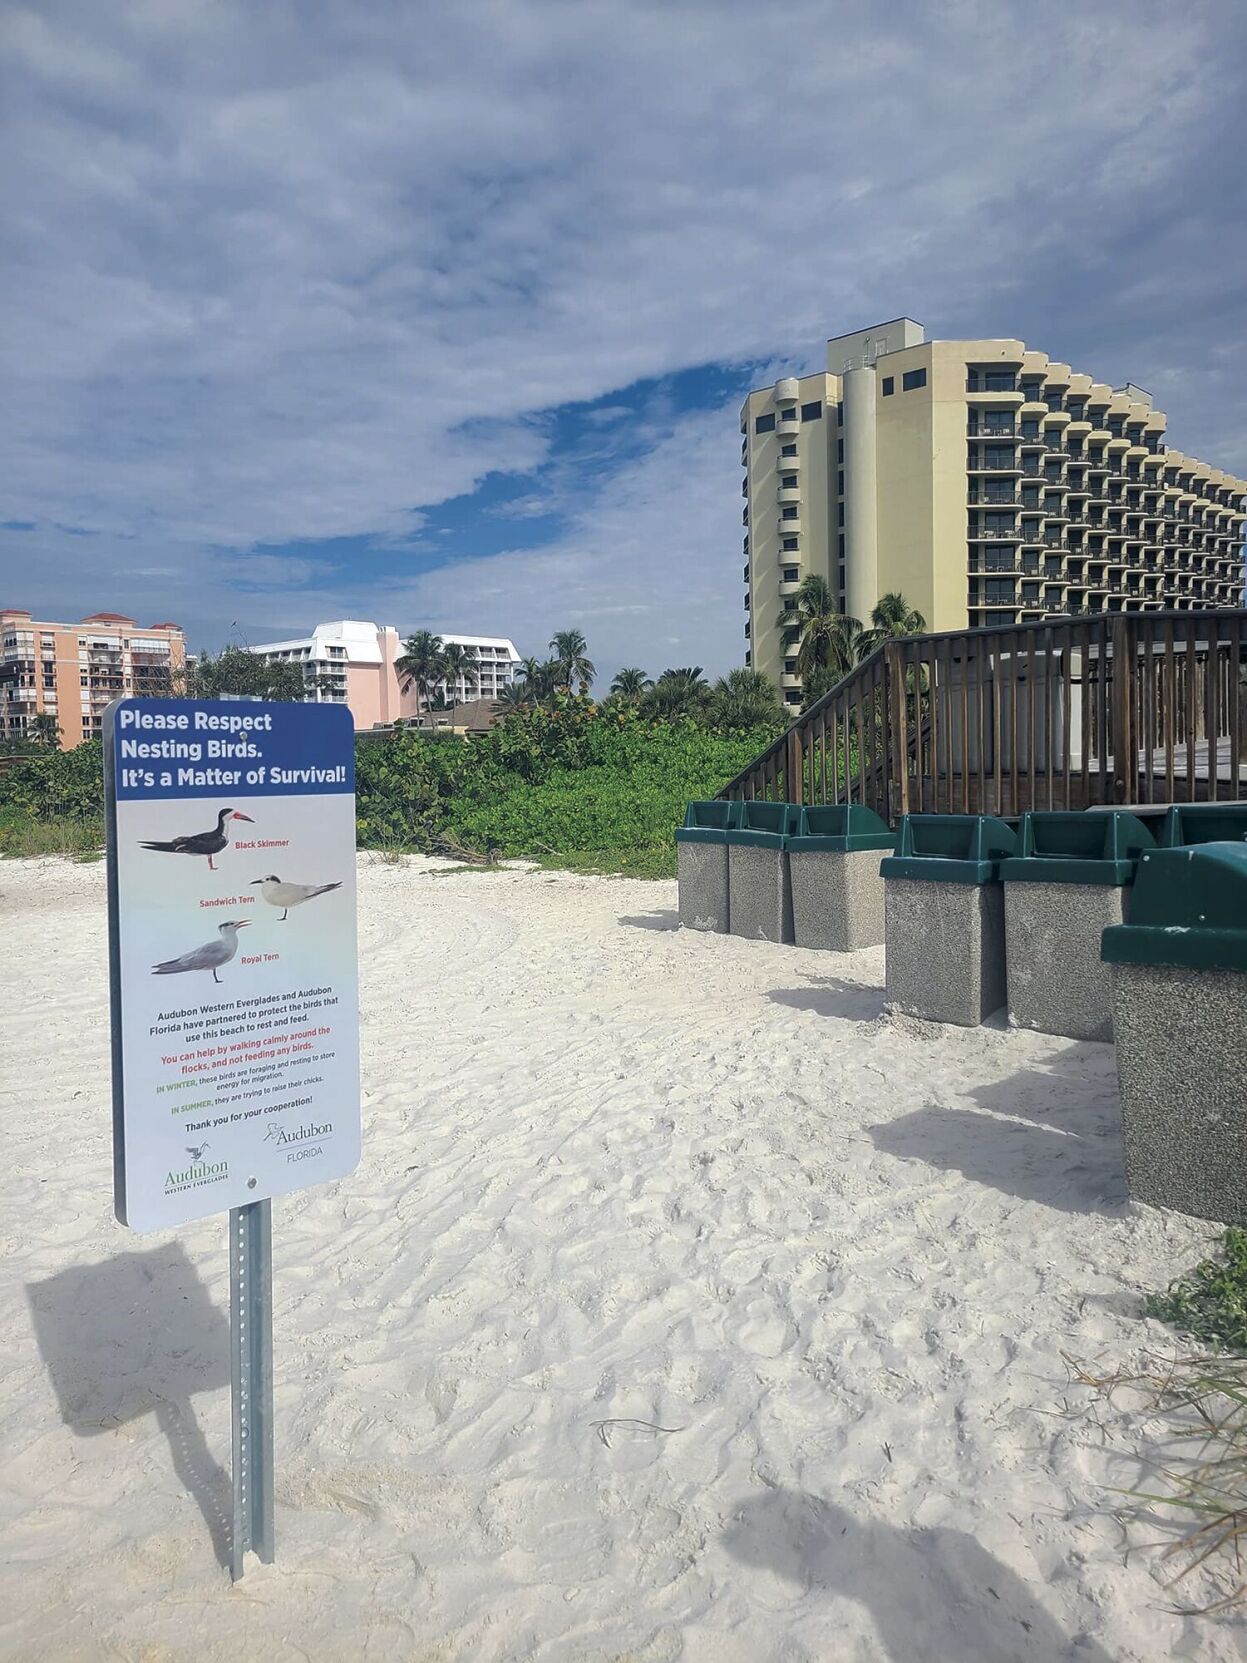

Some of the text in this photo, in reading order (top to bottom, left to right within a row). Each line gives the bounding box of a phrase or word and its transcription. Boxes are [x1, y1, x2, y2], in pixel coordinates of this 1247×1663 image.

[120, 710, 272, 733] Please Respect
[122, 740, 262, 760] Nesting Birds.
[160, 772, 172, 785] a
[178, 768, 241, 785] Matter
[247, 767, 265, 783] of
[270, 766, 346, 783] Survival!
[258, 839, 289, 848] Skimmer
[200, 897, 237, 907] Sandwich
[241, 955, 262, 964] Royal
[158, 987, 331, 1021] Audubon Western Everglades and Audubon
[150, 1024, 181, 1036] Florida
[184, 1021, 203, 1030] have
[206, 1012, 246, 1027] partnered
[259, 1005, 287, 1018] protect
[304, 1000, 322, 1009] birds
[324, 997, 338, 1005] that
[203, 1030, 218, 1039] this
[220, 1025, 244, 1036] beach
[257, 1021, 271, 1029] rest
[274, 1017, 288, 1026] and
[290, 1014, 309, 1023] feed.
[161, 1056, 177, 1064] You
[197, 1048, 215, 1058] help
[230, 1040, 261, 1051] walking
[263, 1035, 288, 1045] calmly
[290, 1029, 316, 1040] around
[182, 1042, 313, 1074] flocks, and not feeding any birds.
[167, 1080, 197, 1091] WINTER,
[199, 1076, 217, 1084] these
[250, 1064, 275, 1074] foraging
[290, 1056, 311, 1065] resting
[217, 1081, 239, 1090] energy
[181, 1100, 213, 1112] SUMMER,
[215, 1096, 229, 1104] they
[244, 1089, 262, 1098] trying
[185, 1096, 312, 1132] Thank you for your cooperation!
[276, 1123, 332, 1145] Audubon
[287, 1147, 323, 1163] FLORIDA
[165, 1161, 228, 1186] Audubon
[165, 1174, 228, 1195] WESTERN EVERGLADES
